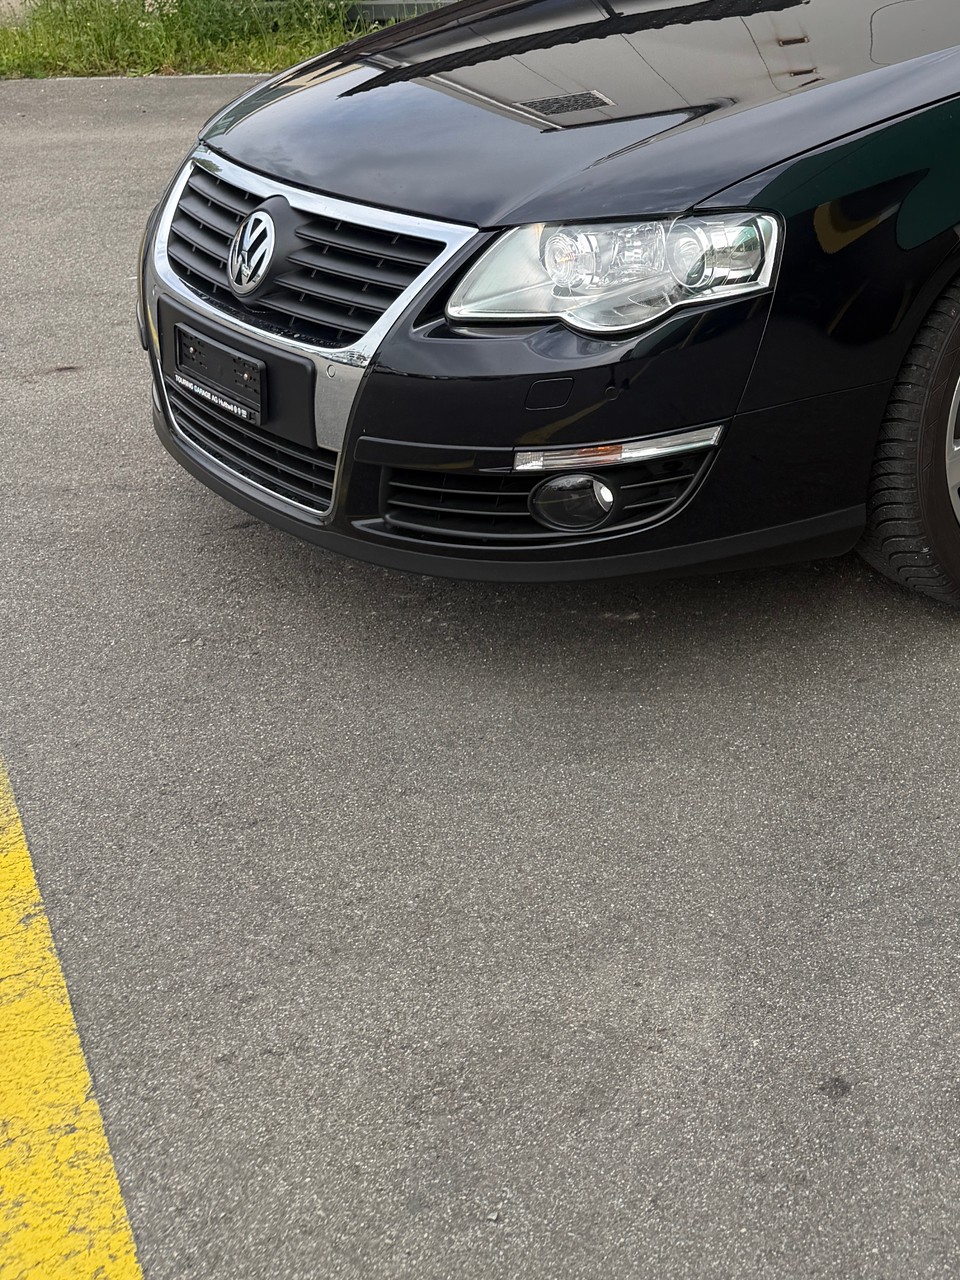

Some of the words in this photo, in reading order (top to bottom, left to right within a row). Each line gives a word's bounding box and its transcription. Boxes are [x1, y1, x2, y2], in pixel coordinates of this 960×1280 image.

[229, 211, 275, 294] VW
[175, 374, 194, 390] TOURING
[194, 385, 211, 400] GARAGE
